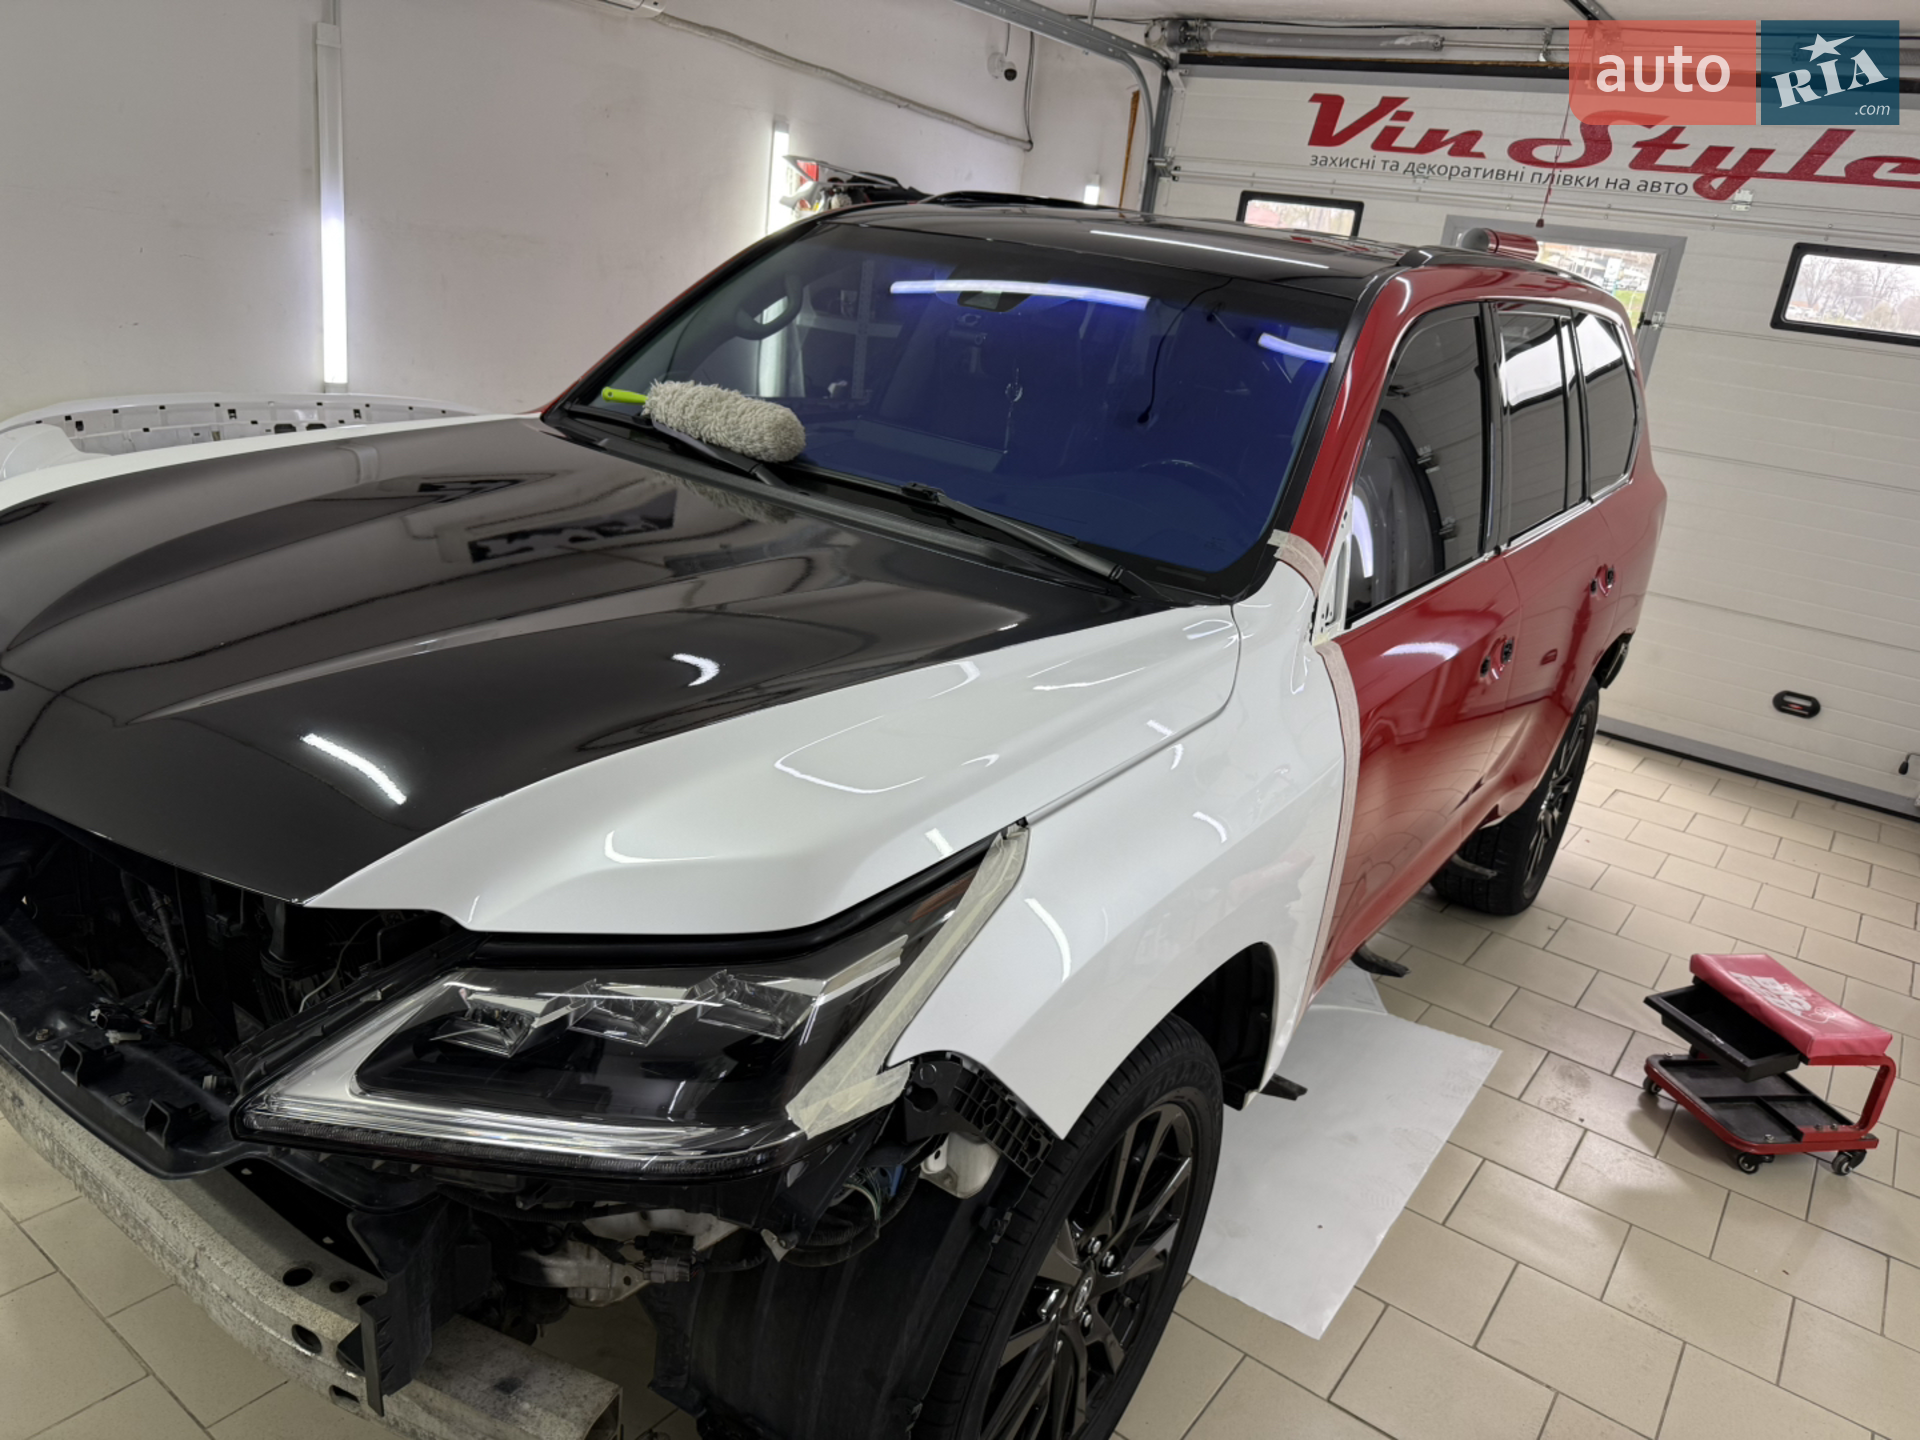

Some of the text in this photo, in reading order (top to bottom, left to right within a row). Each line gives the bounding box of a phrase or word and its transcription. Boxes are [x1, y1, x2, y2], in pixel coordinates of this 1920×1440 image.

[1308, 93, 1920, 201] Vin Style
[1309, 154, 1689, 196] захисні та декоративні плівки на авто
